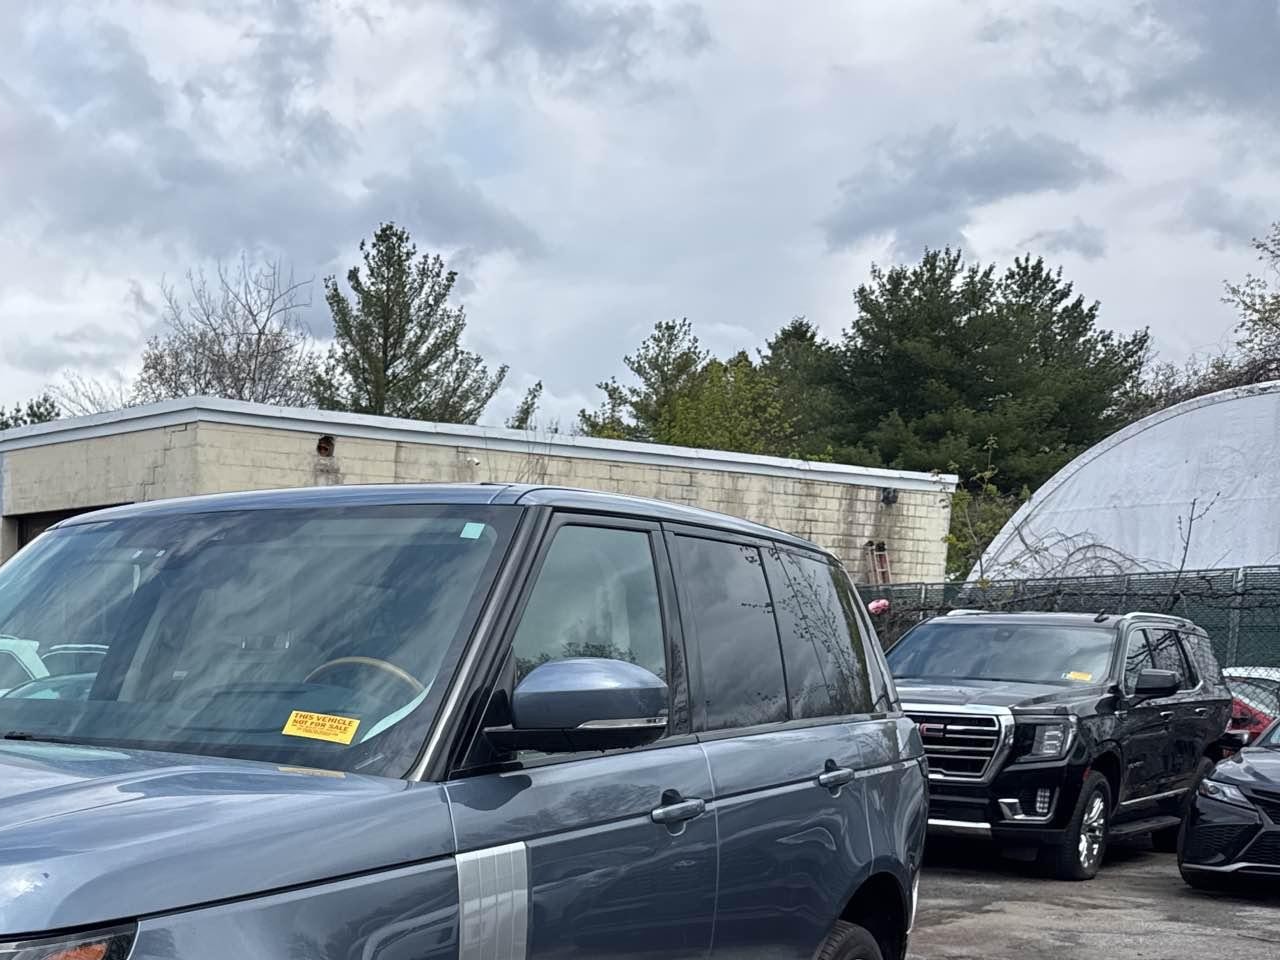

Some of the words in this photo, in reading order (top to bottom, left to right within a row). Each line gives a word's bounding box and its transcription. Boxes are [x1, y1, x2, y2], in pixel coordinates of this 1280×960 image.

[294, 712, 315, 721] THIS
[316, 715, 353, 727] VEHICLE
[329, 723, 349, 732] SALE
